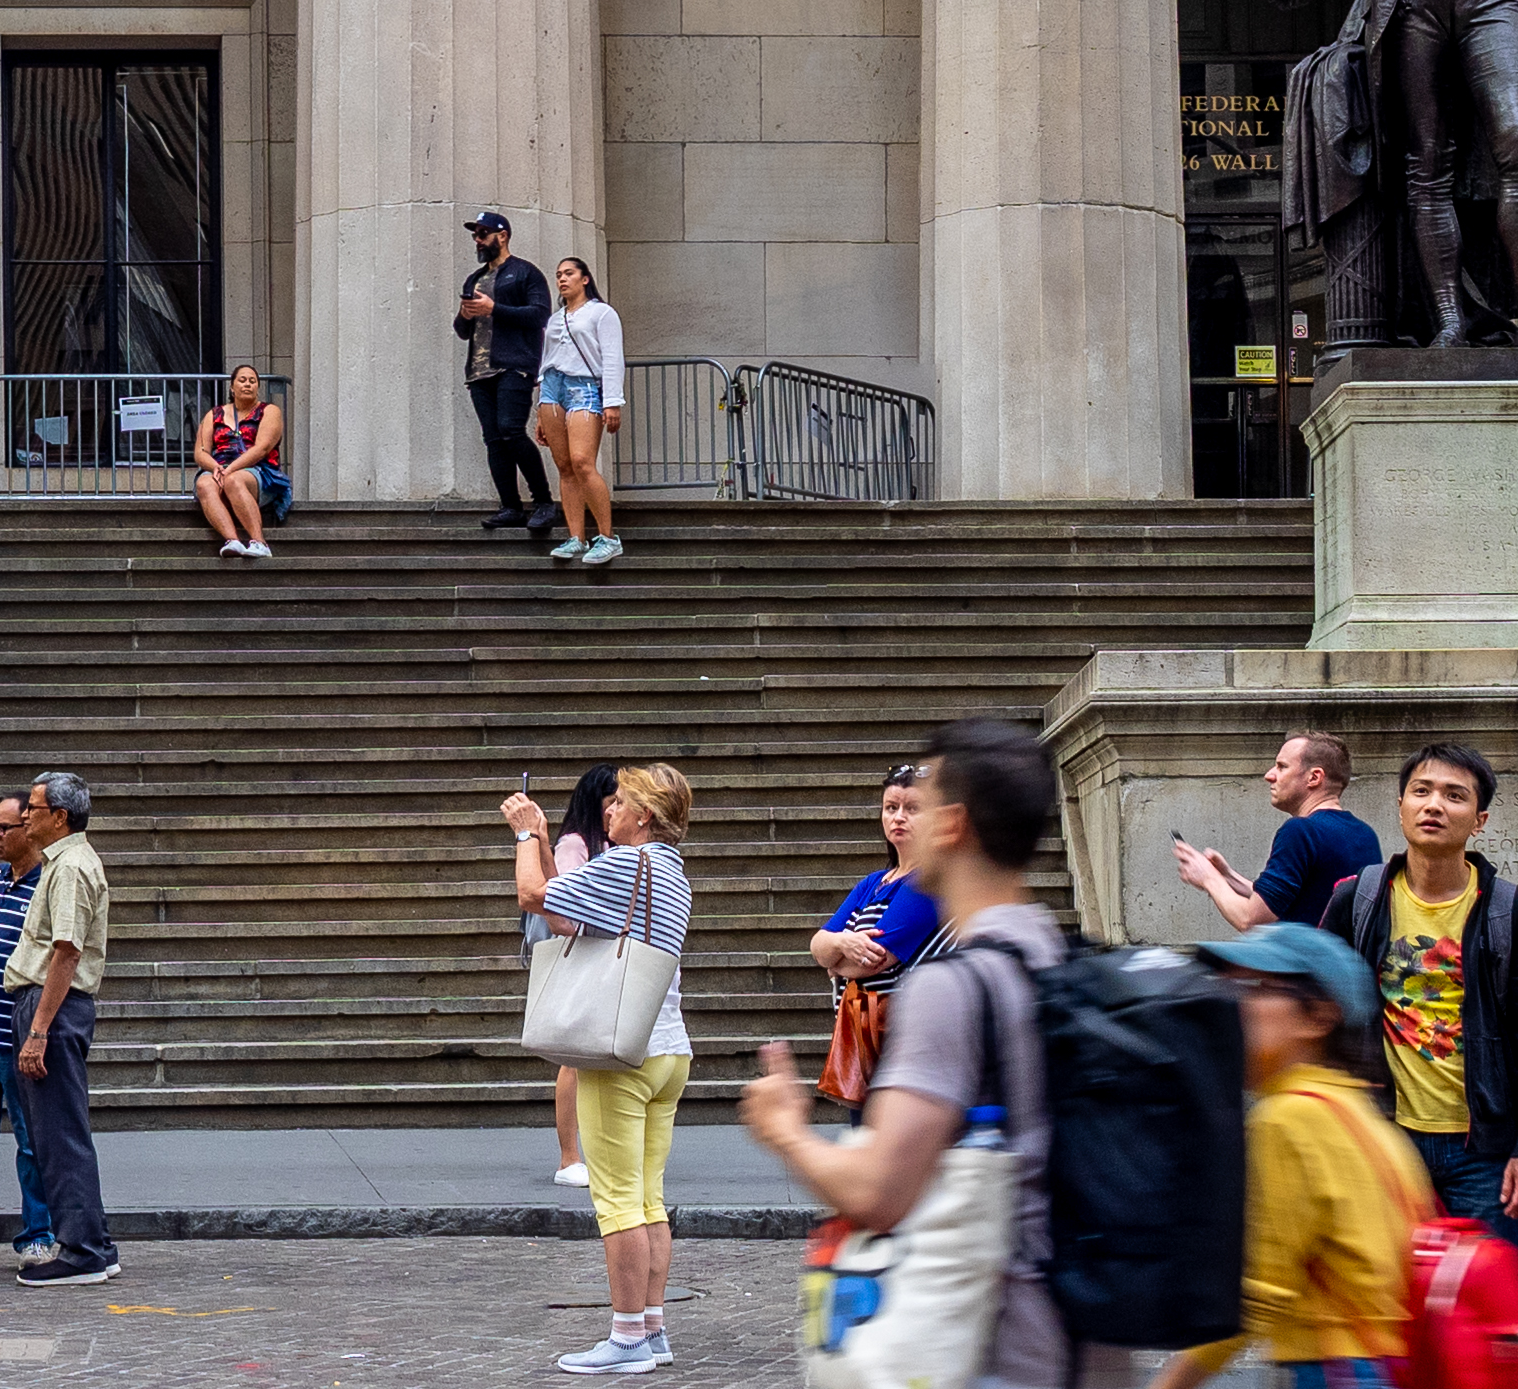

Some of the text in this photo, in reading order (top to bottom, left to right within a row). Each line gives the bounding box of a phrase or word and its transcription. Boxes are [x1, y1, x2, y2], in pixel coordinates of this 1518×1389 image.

[1180, 95, 1286, 112] FEDERA
[1210, 154, 1279, 170] WALL
[1240, 351, 1272, 359] CAUTION
